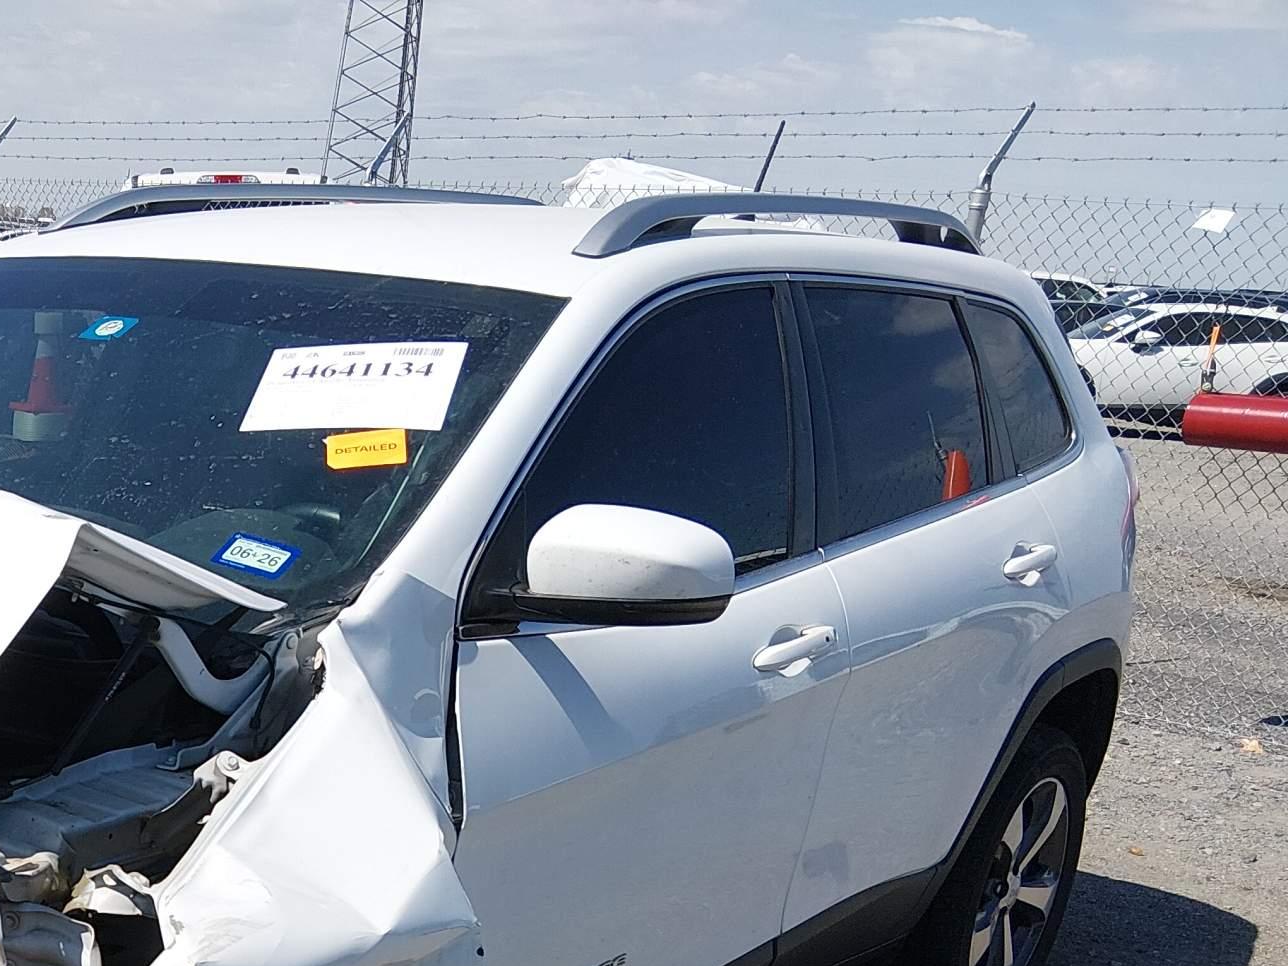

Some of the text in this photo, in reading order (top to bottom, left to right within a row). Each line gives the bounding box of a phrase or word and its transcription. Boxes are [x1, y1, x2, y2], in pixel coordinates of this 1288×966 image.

[282, 361, 435, 379] 44641134
[334, 442, 398, 455] DETAILED
[229, 545, 253, 559] 06
[256, 553, 282, 567] 26
